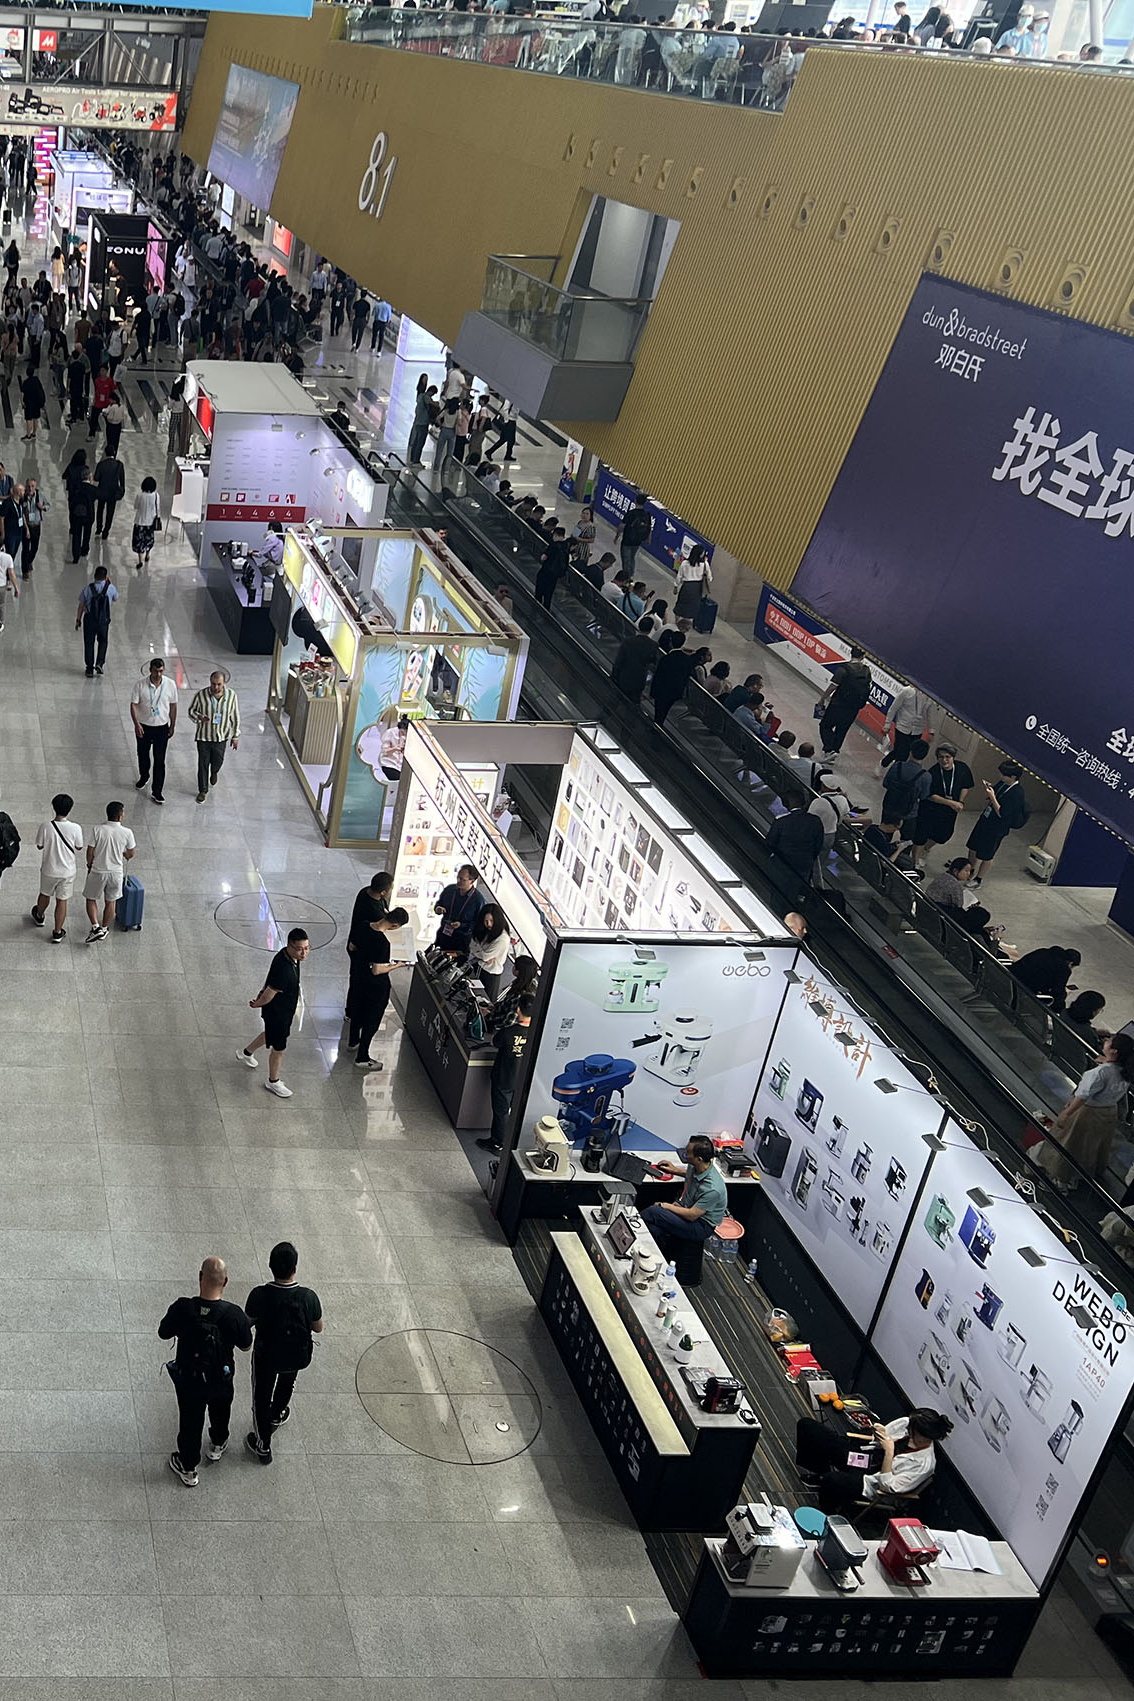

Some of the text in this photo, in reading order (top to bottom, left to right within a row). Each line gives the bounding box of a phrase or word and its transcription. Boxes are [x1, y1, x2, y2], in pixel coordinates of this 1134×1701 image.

[42, 86, 70, 95] AEROPRO
[359, 131, 399, 219] 8.1
[922, 305, 1028, 360] dun&bradstreet
[934, 343, 986, 383] 邓白氏
[722, 963, 771, 977] webo
[1052, 1280, 1119, 1368] DEGN
[1073, 1273, 1127, 1344] WEBO
